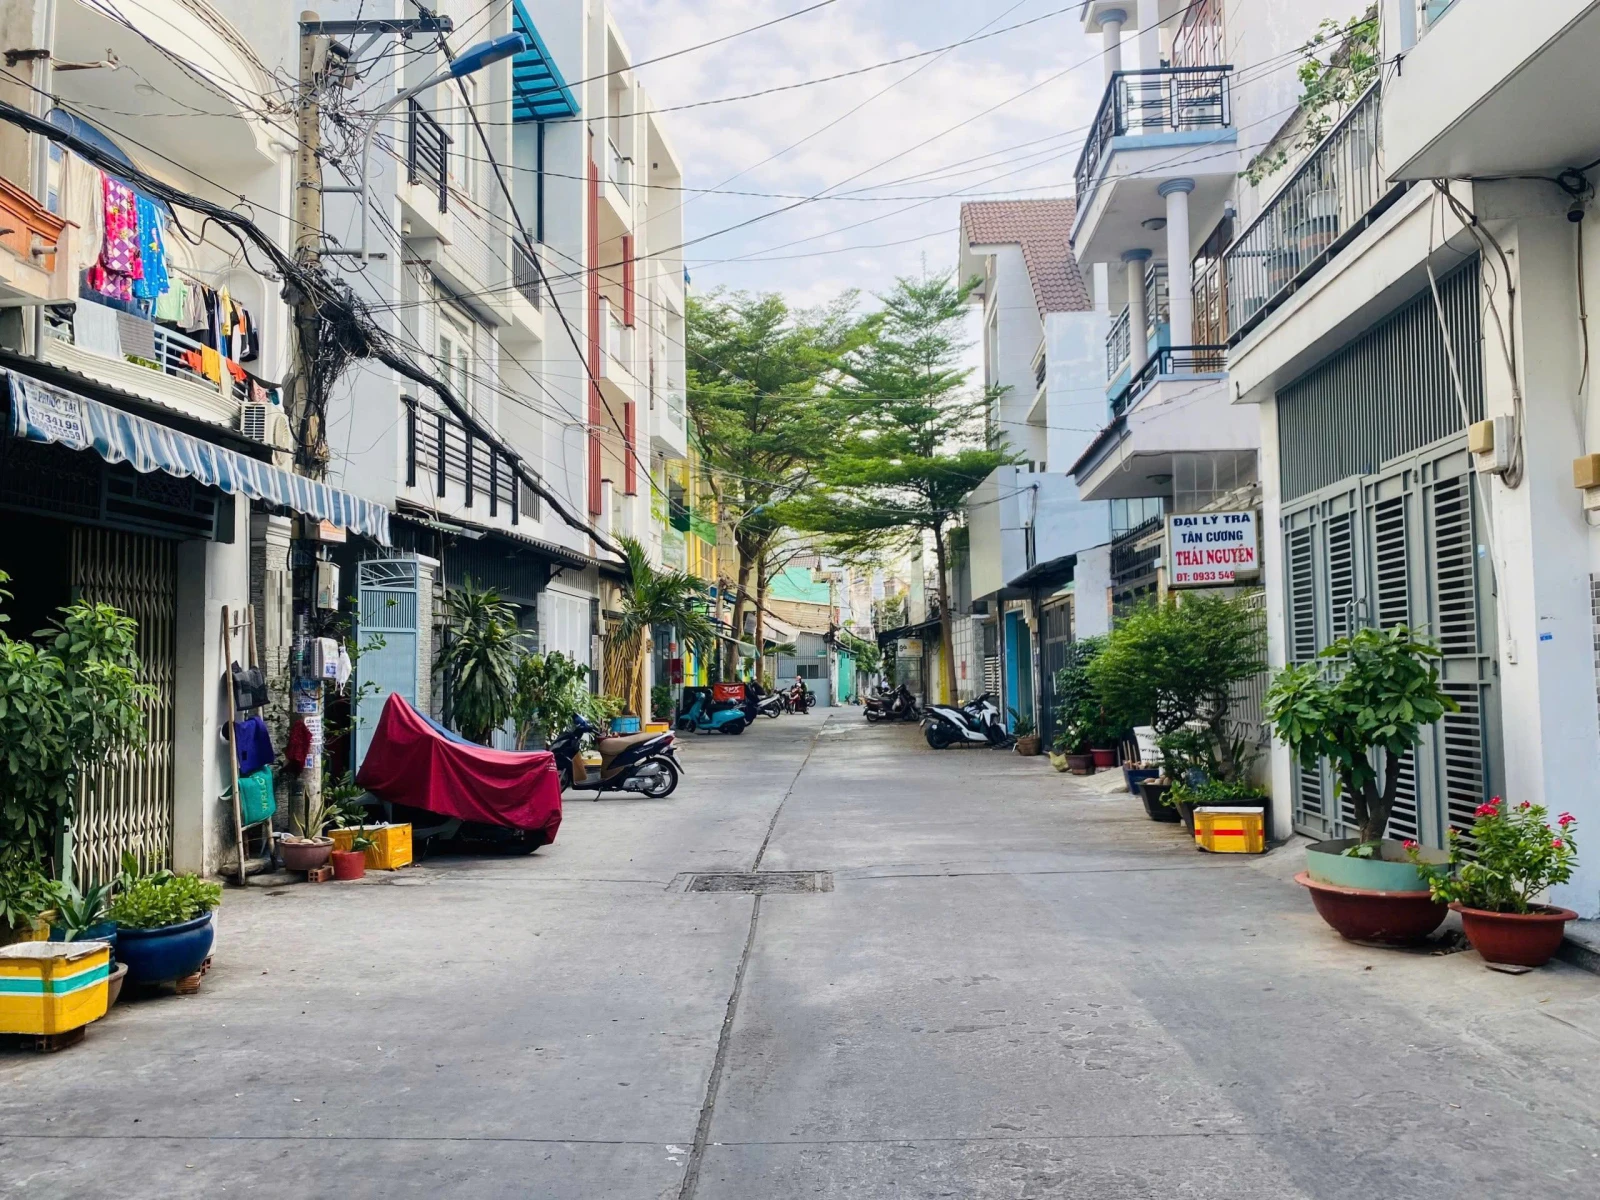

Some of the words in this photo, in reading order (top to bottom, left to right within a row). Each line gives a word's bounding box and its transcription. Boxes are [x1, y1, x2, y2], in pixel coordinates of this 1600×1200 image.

[1174, 517, 1198, 527] ĐẠI
[1203, 514, 1218, 525] LÝ
[1223, 513, 1250, 523] TRÀ
[1181, 531, 1203, 543] TÂN
[1206, 530, 1243, 542] CƯƠNG
[1176, 546, 1203, 566] THÁI
[1207, 544, 1254, 564] NGUYÊN
[1176, 572, 1190, 581] ĐT:
[1193, 571, 1215, 580] 0933
[1218, 570, 1235, 579] 549
